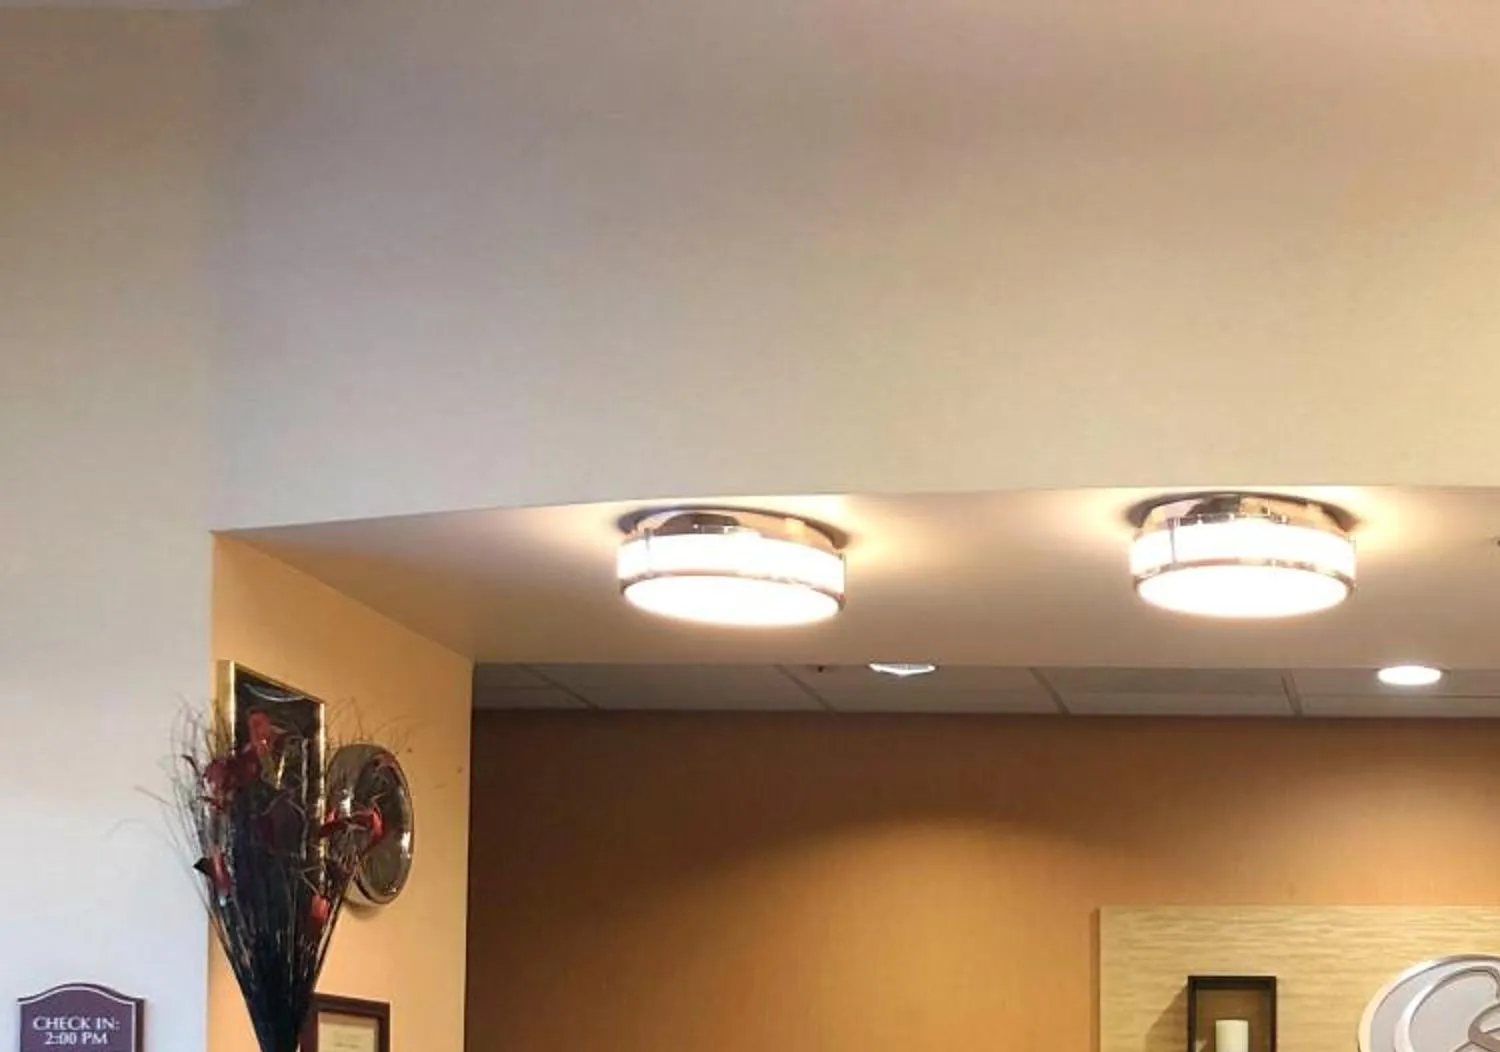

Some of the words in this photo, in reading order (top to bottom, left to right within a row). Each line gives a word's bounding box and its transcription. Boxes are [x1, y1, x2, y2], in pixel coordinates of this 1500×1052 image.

[33, 1015, 91, 1031] CHECK
[95, 1016, 120, 1031] IN:
[44, 1031, 77, 1045] 2:00
[82, 1032, 108, 1045] PM
